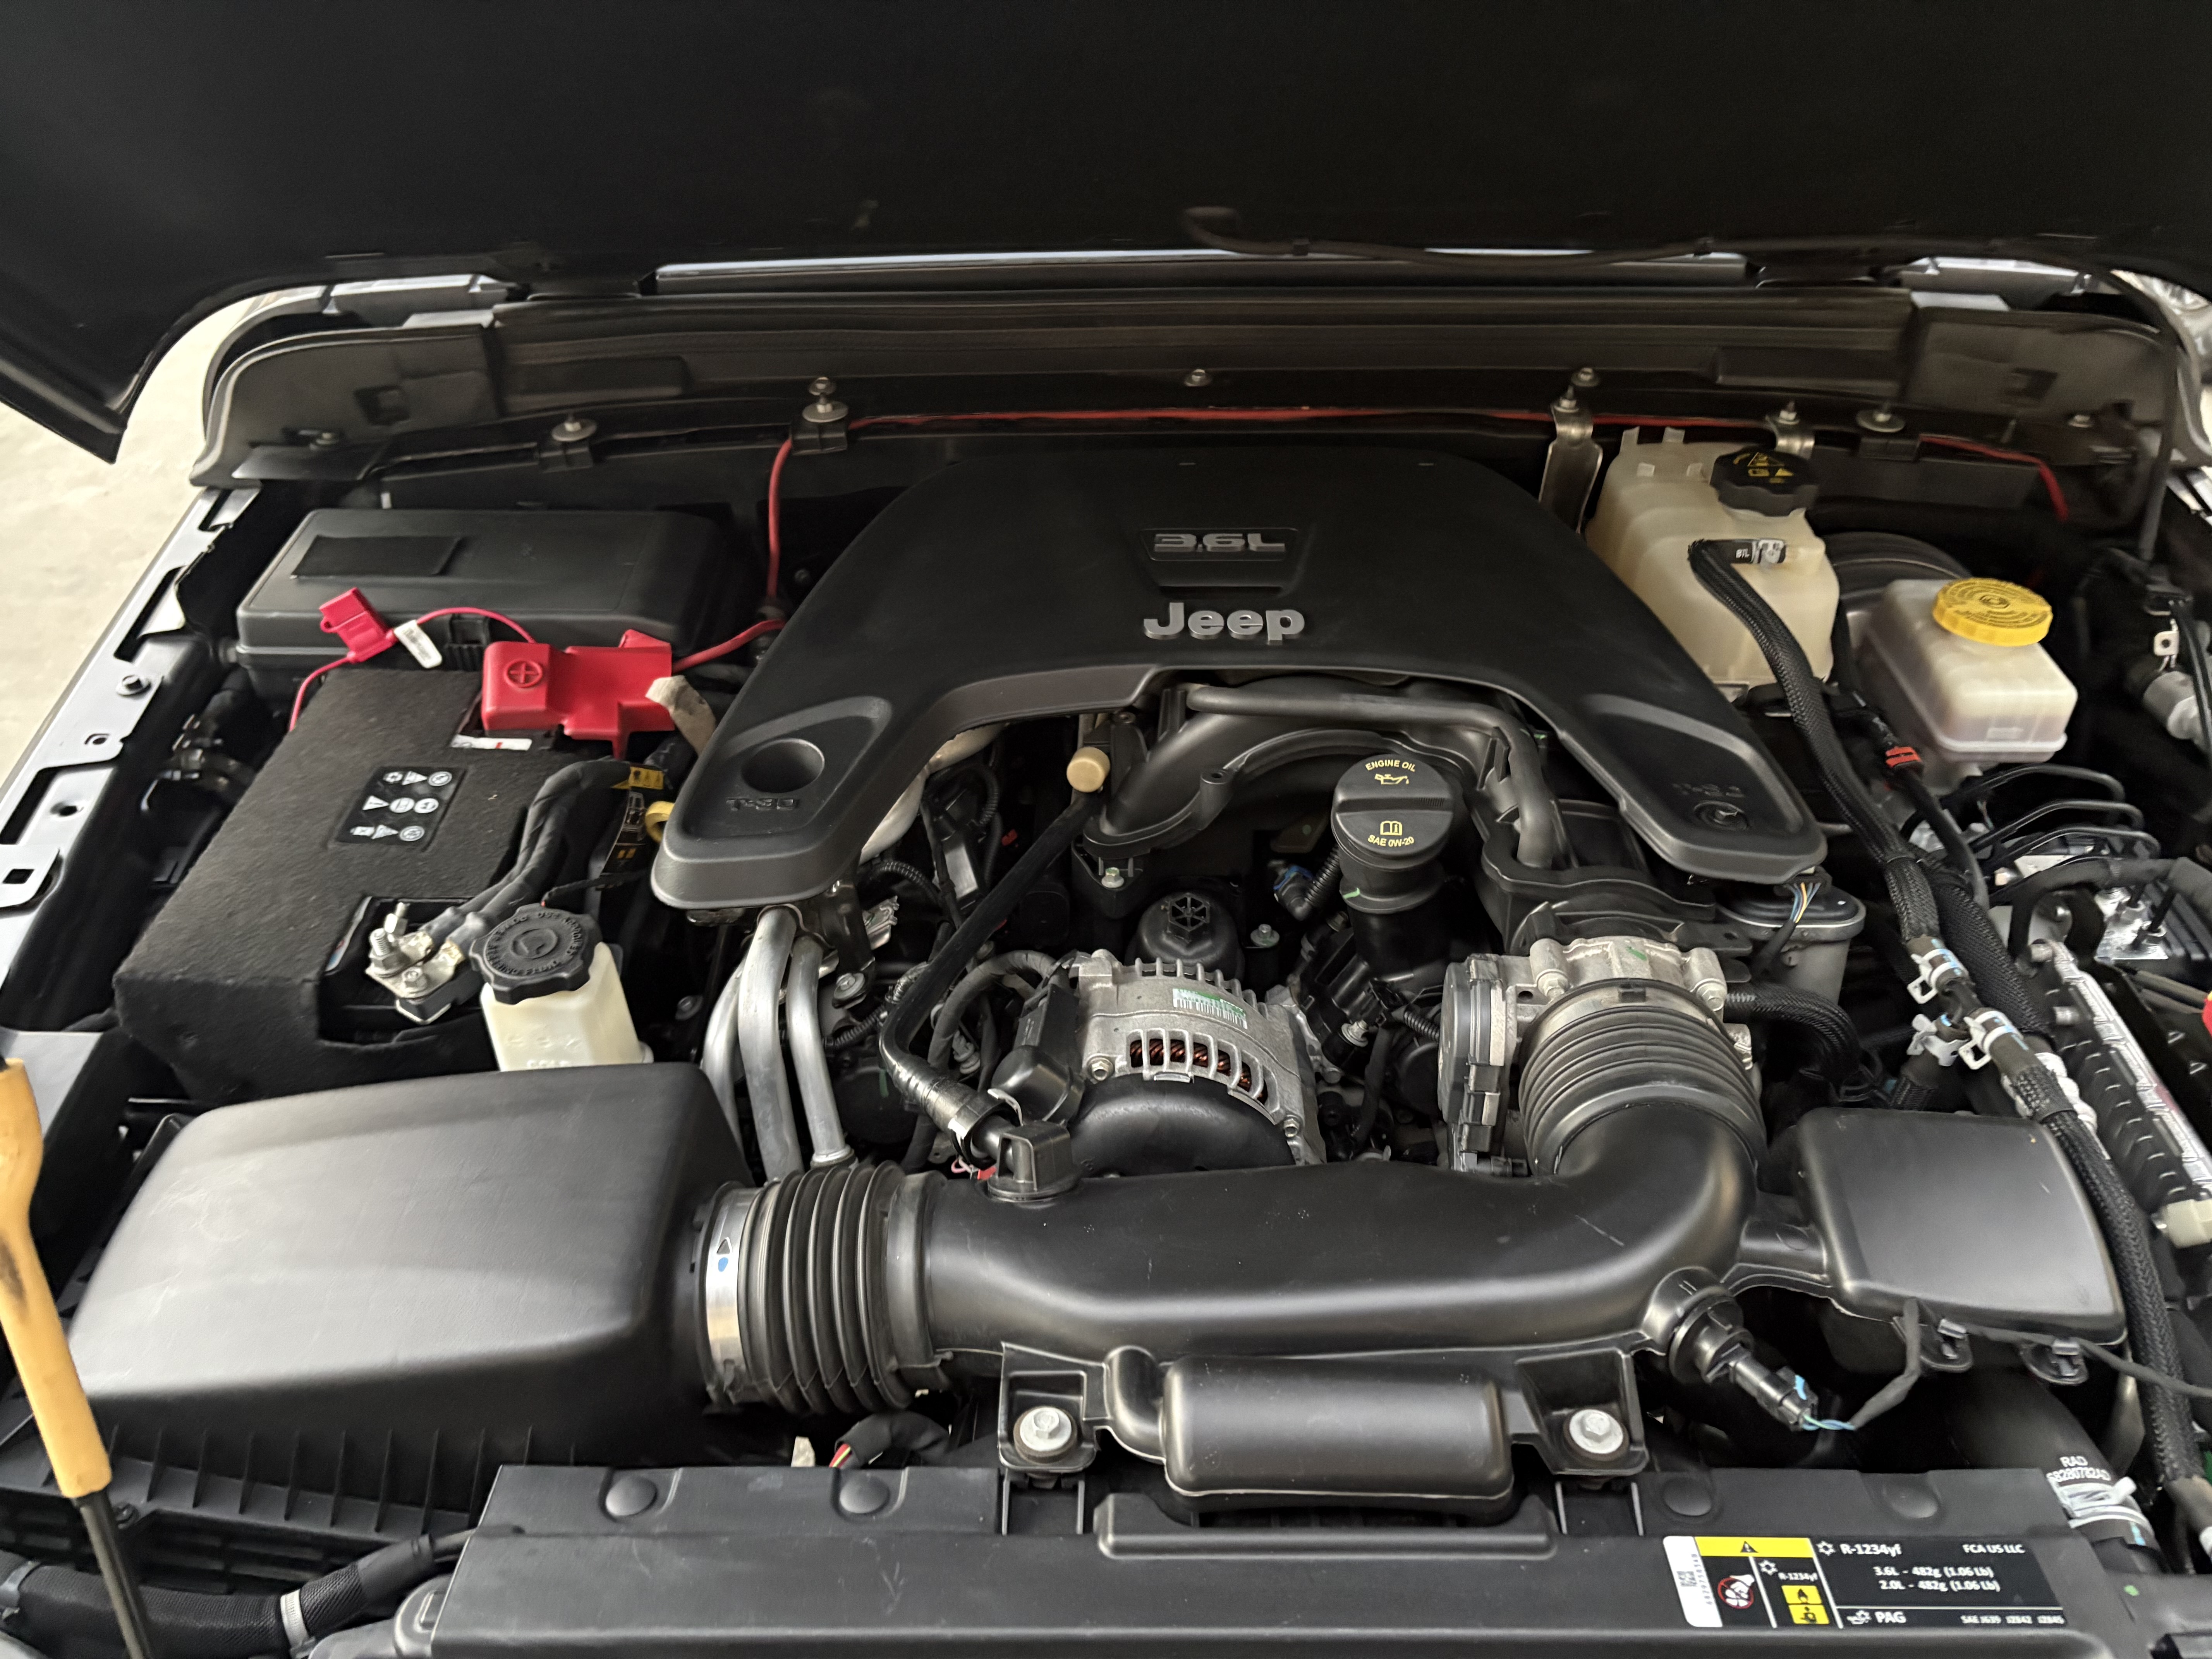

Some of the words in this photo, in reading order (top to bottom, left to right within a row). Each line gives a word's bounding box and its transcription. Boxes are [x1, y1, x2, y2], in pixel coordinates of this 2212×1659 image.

[1154, 532, 1285, 553] 3.6L
[1143, 602, 1305, 645] Jeep
[1365, 759, 1400, 771] ENGINE
[1402, 761, 1416, 772] OIL
[1368, 835, 1386, 847] SAE
[1388, 836, 1415, 847] 0W-20
[2059, 1456, 2088, 1467] RAD
[1839, 1543, 1903, 1557] R-1234yf
[1962, 1544, 1986, 1554] FCA
[1986, 1544, 2004, 1554] US
[2004, 1544, 2026, 1554] LLC
[1873, 1566, 1900, 1576] 3.6L
[1878, 1580, 1906, 1590] 2.0L
[1874, 1611, 1907, 1623] PAG
